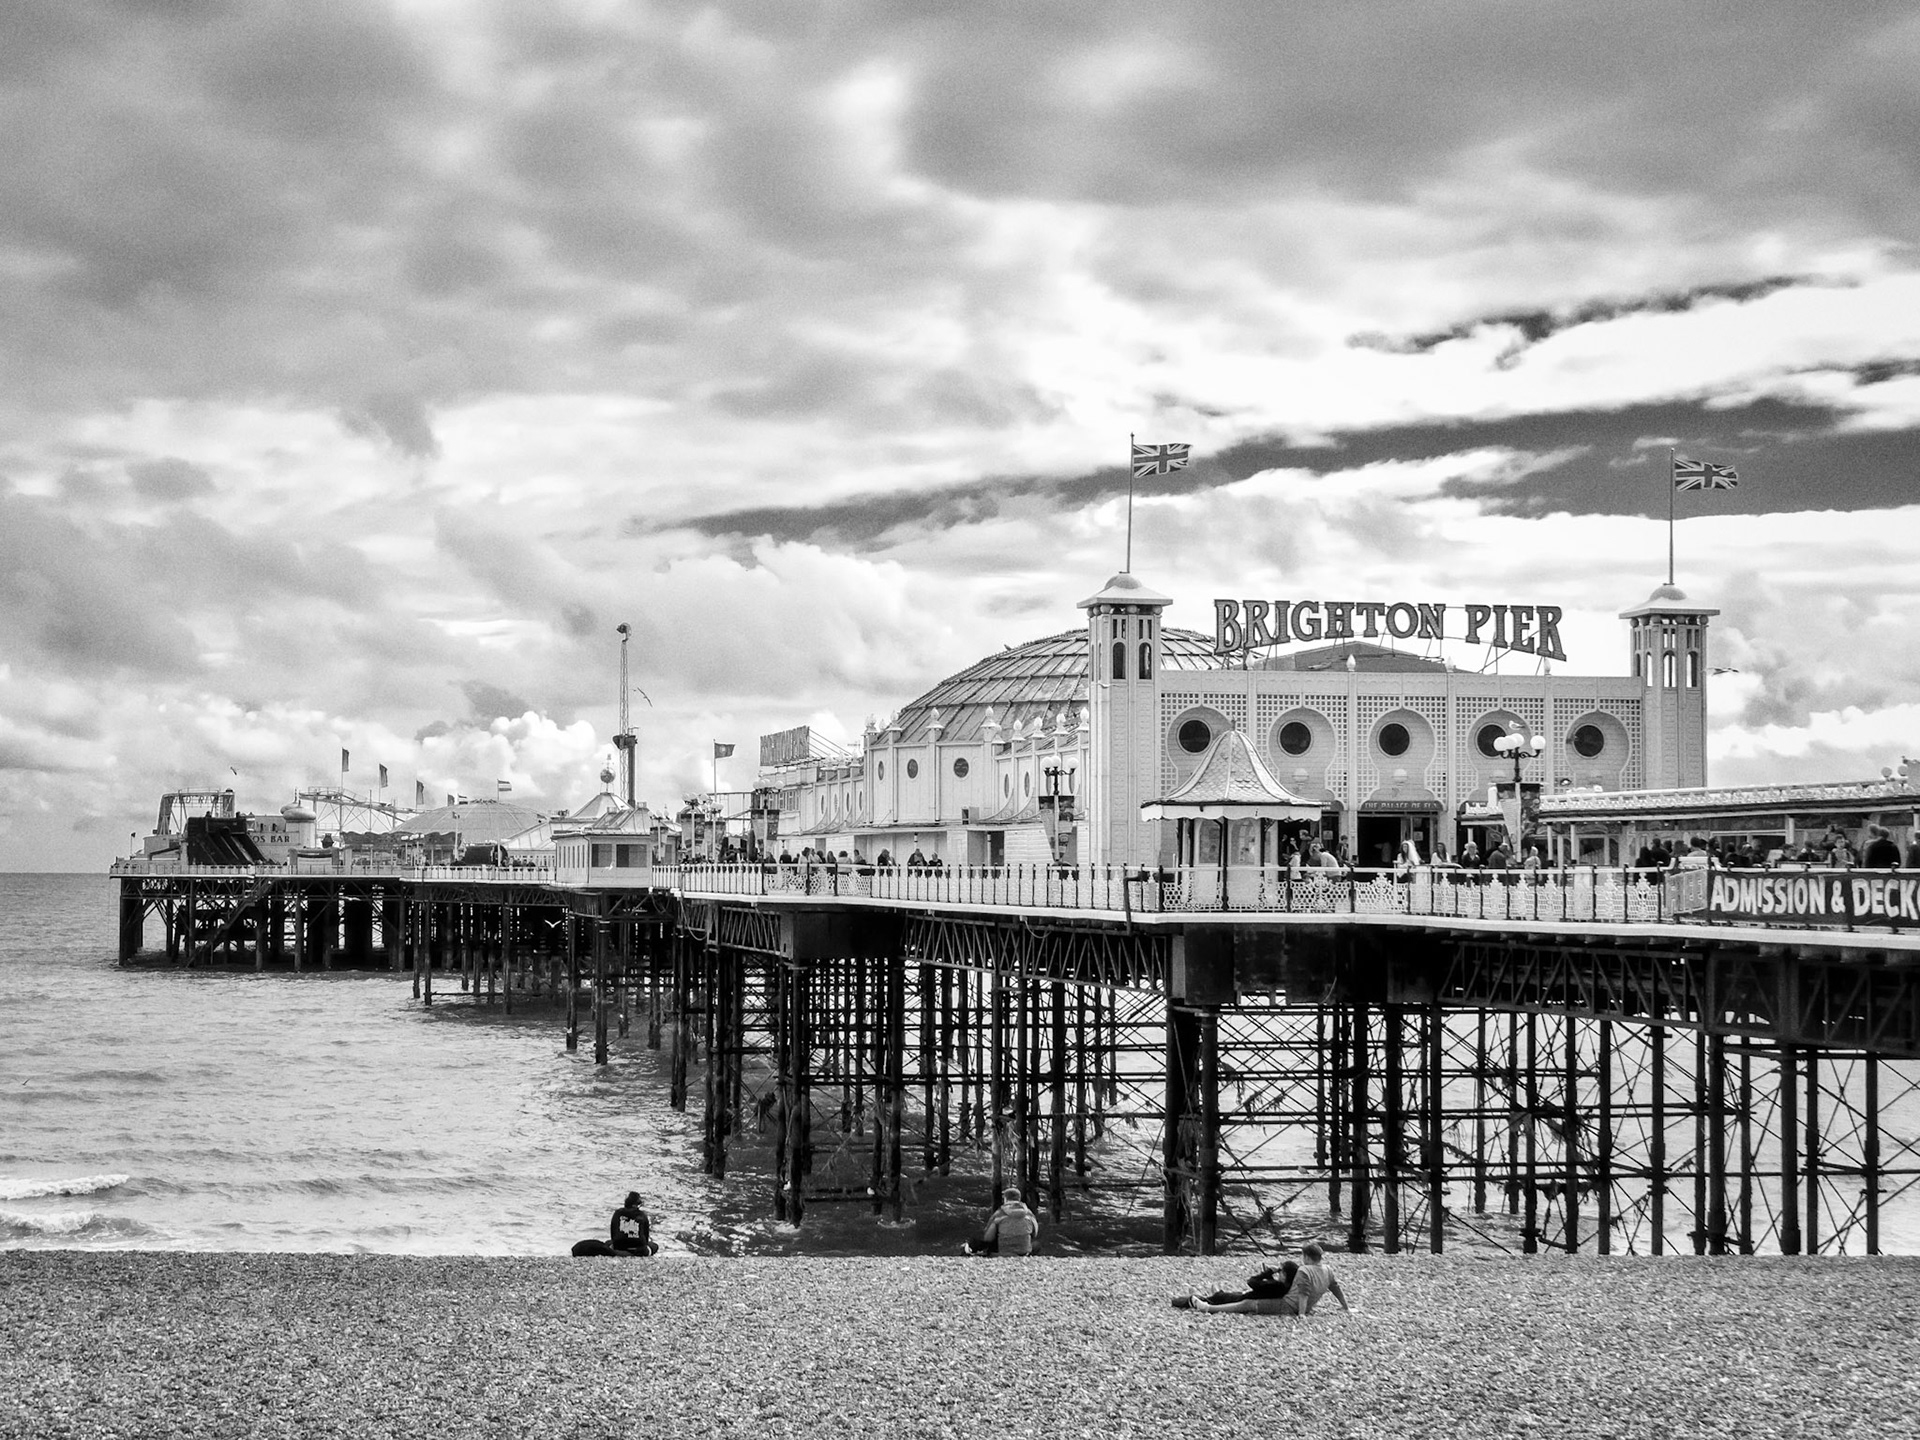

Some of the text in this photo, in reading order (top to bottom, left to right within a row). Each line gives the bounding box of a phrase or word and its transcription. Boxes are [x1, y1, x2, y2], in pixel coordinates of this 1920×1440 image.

[1213, 598, 1567, 662] BRIGHTON PIER
[252, 835, 290, 843] OS BAR
[1709, 875, 1920, 920] ADMISSION & DECK
